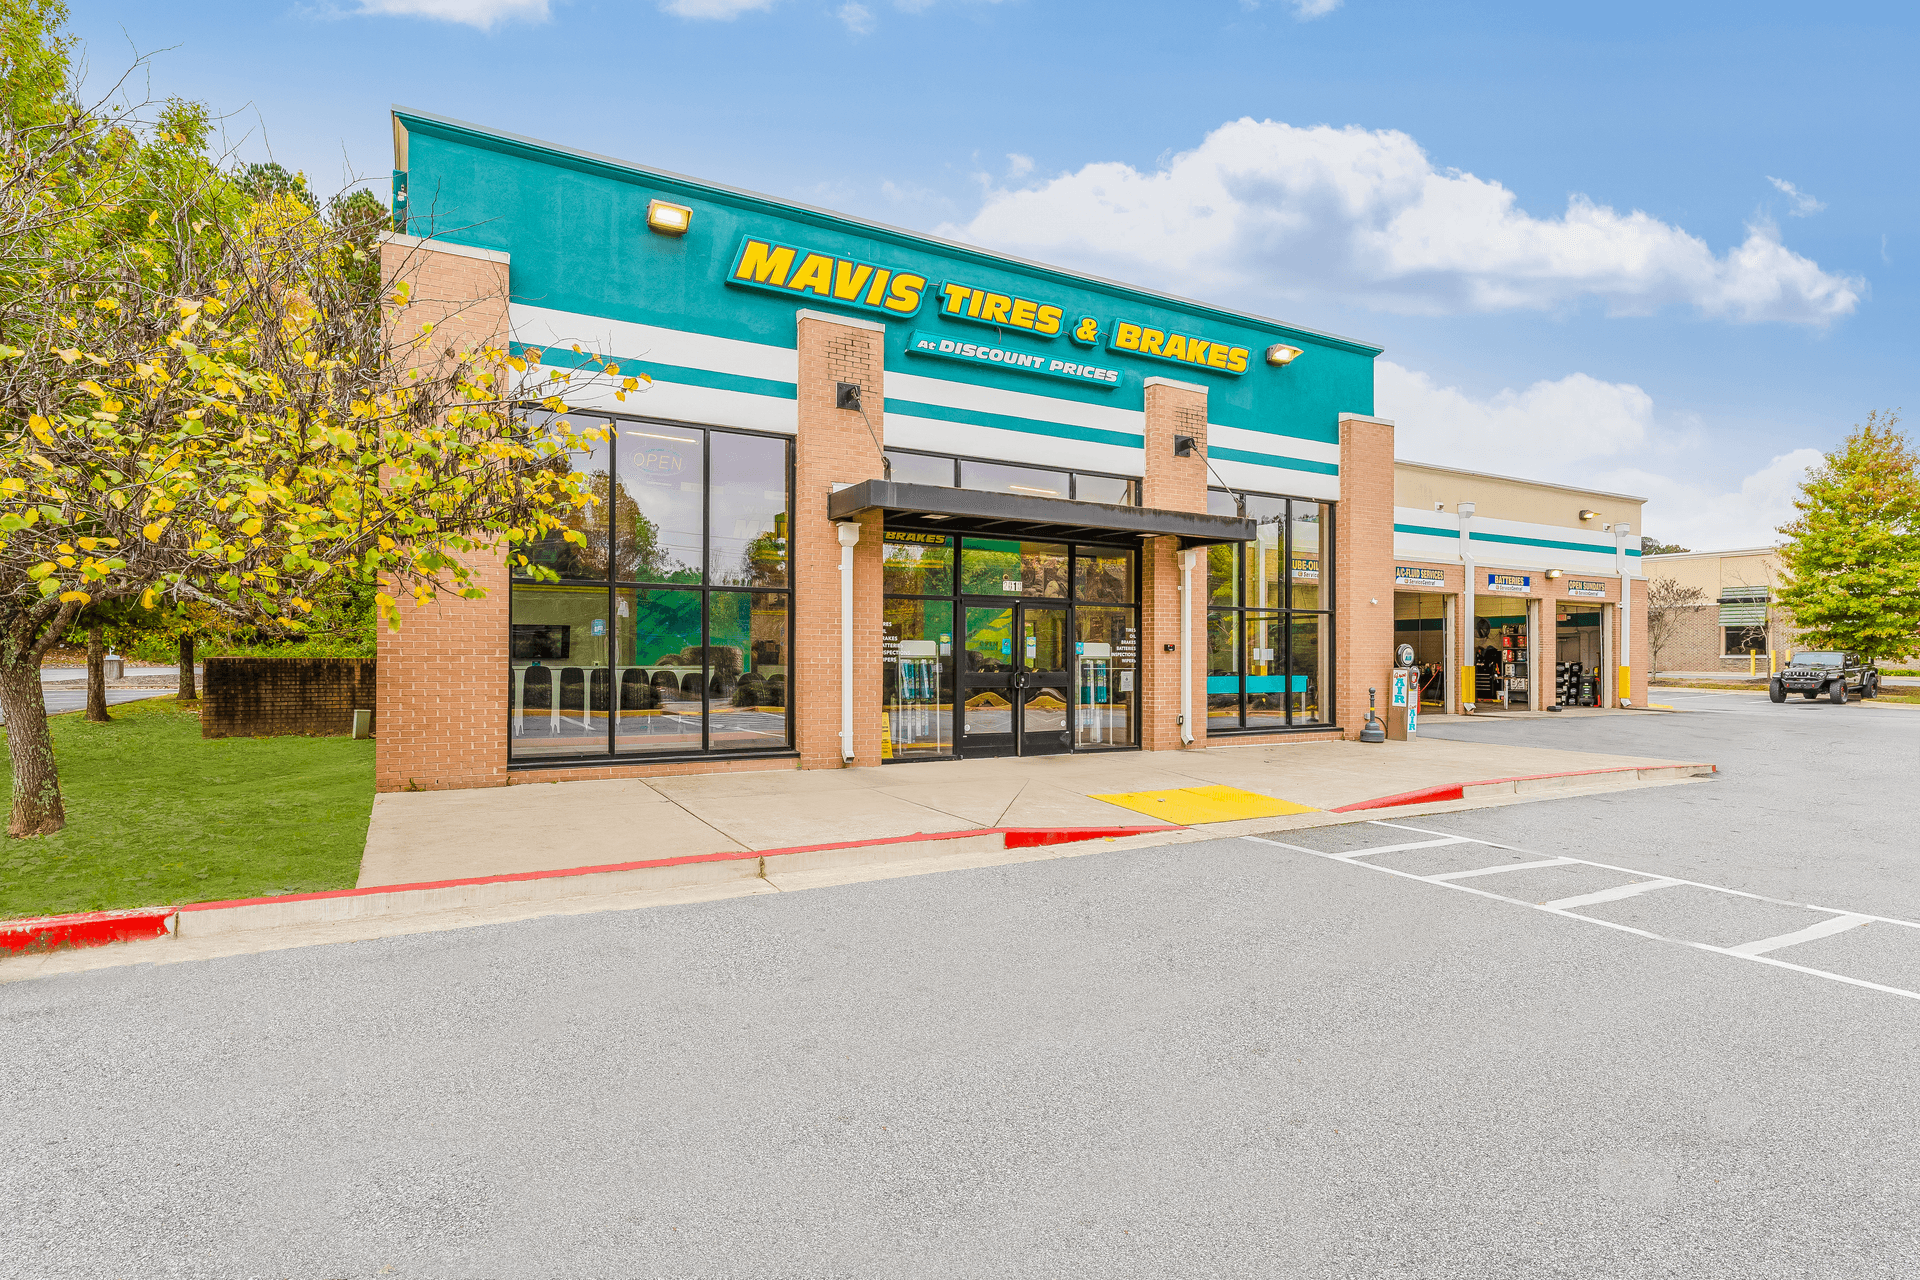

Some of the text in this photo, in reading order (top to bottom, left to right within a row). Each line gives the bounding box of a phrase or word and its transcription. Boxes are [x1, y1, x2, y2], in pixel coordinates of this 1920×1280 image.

[734, 239, 1249, 373] MAVIS TIRES & BRAKES
[916, 339, 1119, 383] At DISCOUNT PRICES
[633, 452, 682, 471] OPEN
[885, 531, 946, 544] BRAKES
[1495, 575, 1524, 586] BATTERIES
[1394, 677, 1405, 704] AIR
[1408, 709, 1416, 731] AIR
